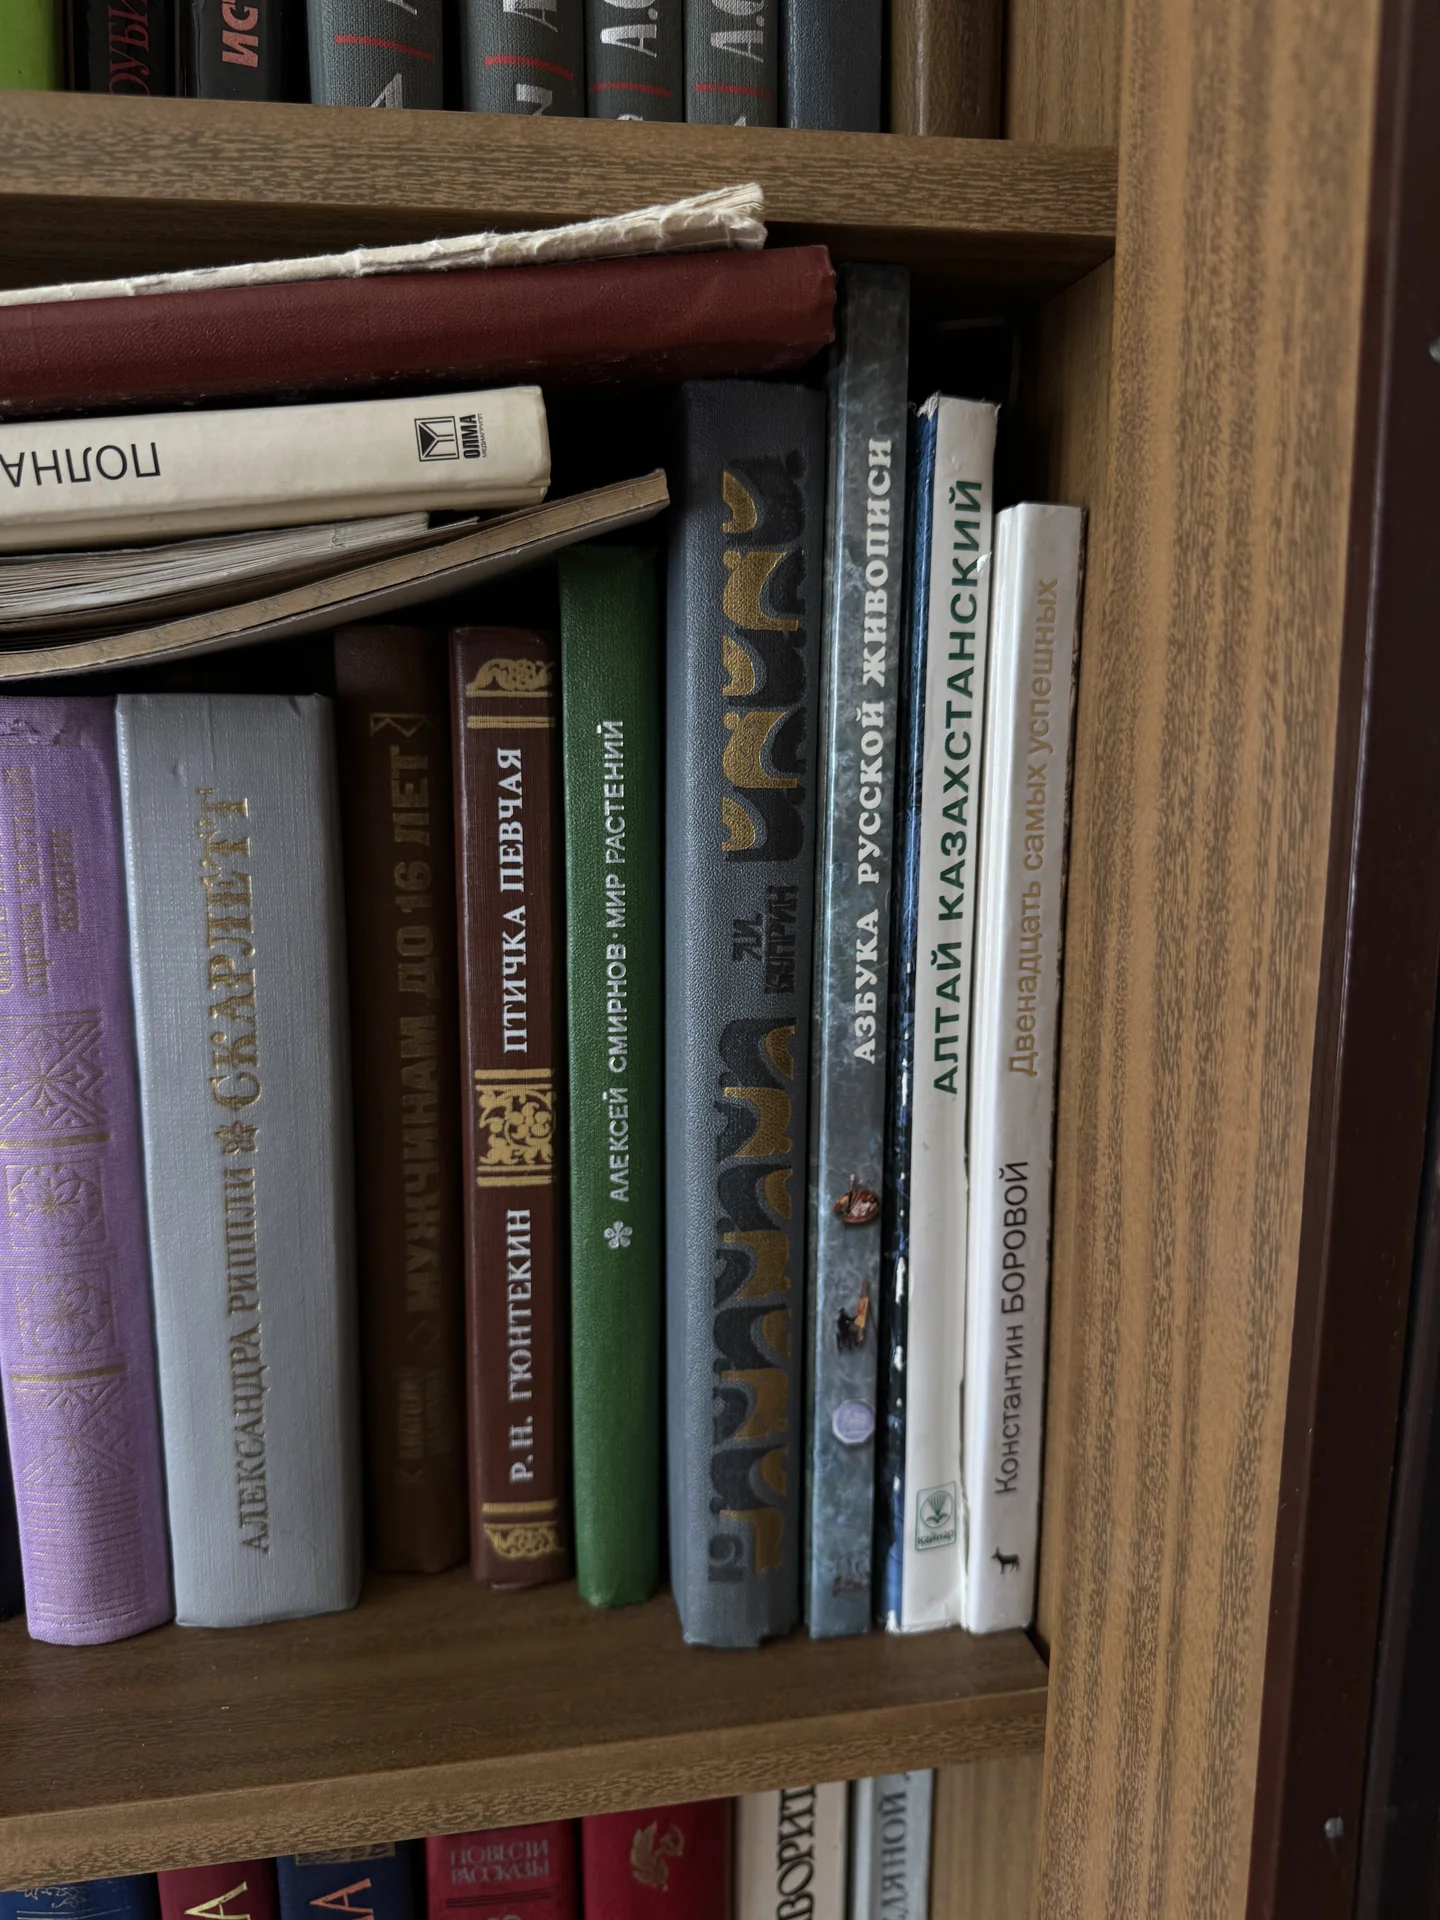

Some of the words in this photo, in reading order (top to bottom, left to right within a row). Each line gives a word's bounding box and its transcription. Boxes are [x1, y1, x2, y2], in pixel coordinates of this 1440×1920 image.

[222, 0, 258, 67] ИС
[600, 0, 657, 58] А.
[0, 442, 161, 487] ПОЛНА
[459, 414, 481, 459] ОЛМА
[862, 438, 892, 687] ЖИВОПИСИ
[938, 480, 982, 921] КАЗАХСТАНСКИЙ
[1028, 578, 1058, 755] успешных
[390, 744, 431, 848] ЛЕТ
[497, 748, 525, 893] ПЕВЧАЯ
[596, 720, 626, 865] РАСТЕНИЙ
[855, 701, 885, 885] РУССКОЙ
[1023, 763, 1047, 871] самых
[196, 787, 262, 1112] СКАРЛЕТТ
[394, 861, 432, 913] 16
[605, 873, 626, 928] МИР
[397, 925, 441, 999] ДО
[502, 904, 528, 1053] ПТИЧКА
[606, 943, 631, 1073] СМИРНОВ
[853, 909, 879, 1064] АЗБУКА
[930, 942, 962, 1095] АЛТАЙ
[1008, 881, 1043, 1077] Двенадцать
[399, 1014, 441, 1312] МУЖЧИНАМ
[602, 1087, 630, 1202] АЛЕКСЕЙ
[224, 1167, 261, 1317] РИППЛИ
[507, 1209, 533, 1401] ГЮНТЕКИН
[999, 1161, 1029, 1315] БОРОВОЙ
[230, 1321, 270, 1555] АЛЕКСАНДРА
[510, 1415, 534, 1450] Н.
[510, 1455, 534, 1483] Р.
[995, 1324, 1024, 1495] Константин
[450, 1839, 549, 1866] ПОВЕСТИ
[451, 1857, 549, 1885] РАССКАЗЫ
[776, 1784, 816, 1920] ВОРИТ
[877, 1791, 910, 1920] ДЯНОЙ
